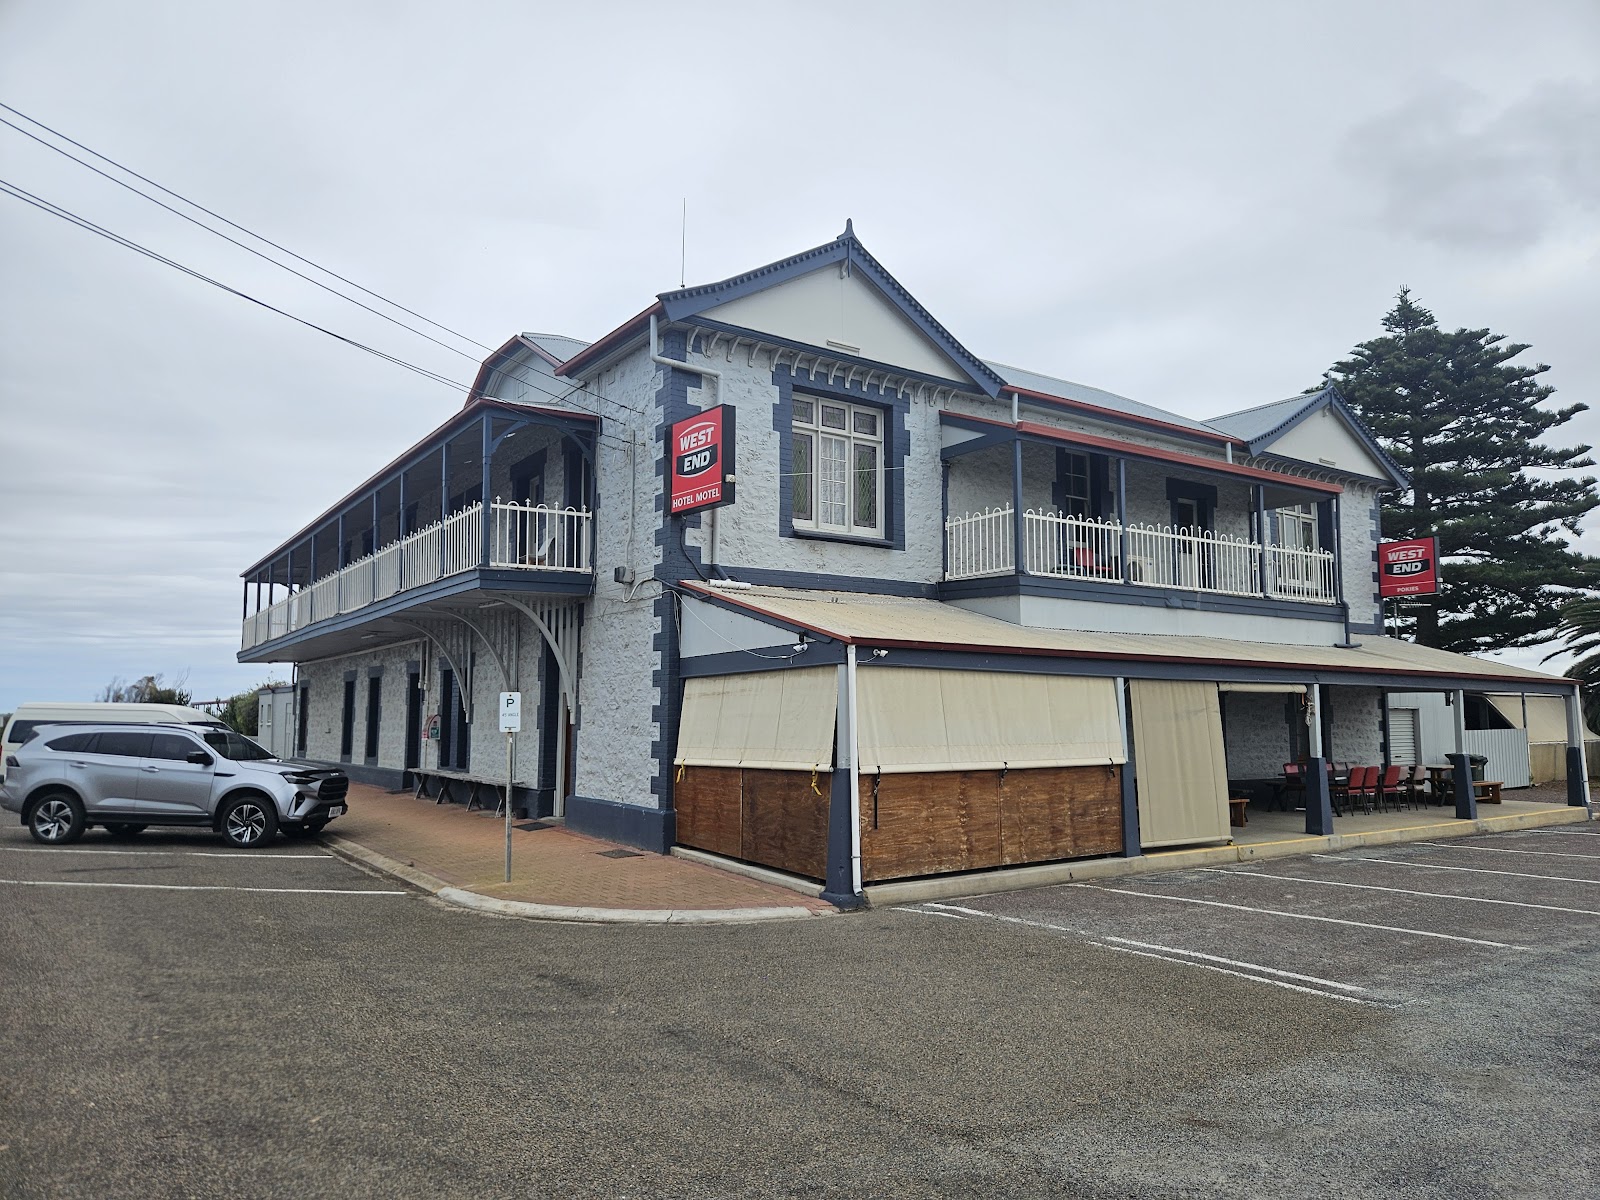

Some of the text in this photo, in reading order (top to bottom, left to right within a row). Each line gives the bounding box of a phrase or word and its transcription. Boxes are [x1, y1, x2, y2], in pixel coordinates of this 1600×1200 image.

[680, 427, 715, 451] WEST
[683, 451, 711, 472] END
[672, 488, 720, 508] HOTEL MOTEL
[1388, 549, 1425, 561] WEST
[1393, 562, 1422, 573] END
[506, 698, 515, 708] P
